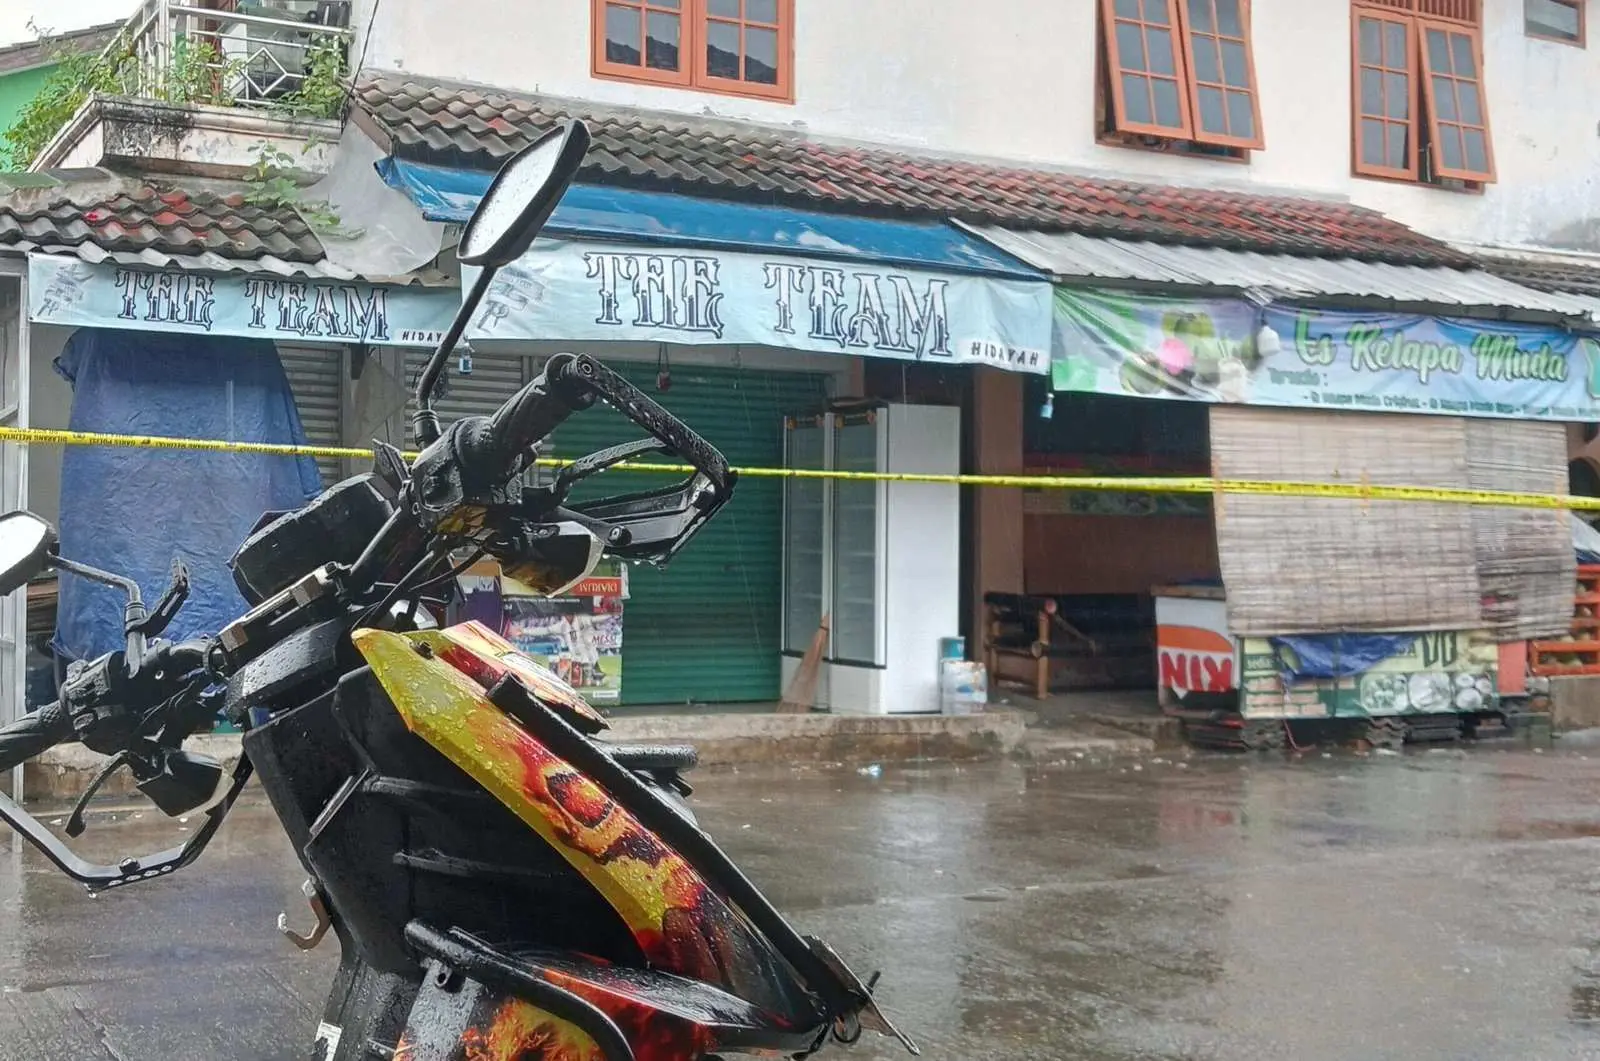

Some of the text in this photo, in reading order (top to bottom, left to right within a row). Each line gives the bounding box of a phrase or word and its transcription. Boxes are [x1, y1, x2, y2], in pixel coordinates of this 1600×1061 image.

[115, 268, 215, 331] THE
[245, 277, 390, 343] TEAM
[584, 252, 724, 338] THE
[764, 262, 953, 360] TEAM
[971, 342, 1039, 366] HIDAYAH
[1345, 321, 1463, 384] Kelapa
[1471, 332, 1568, 382] Muda
